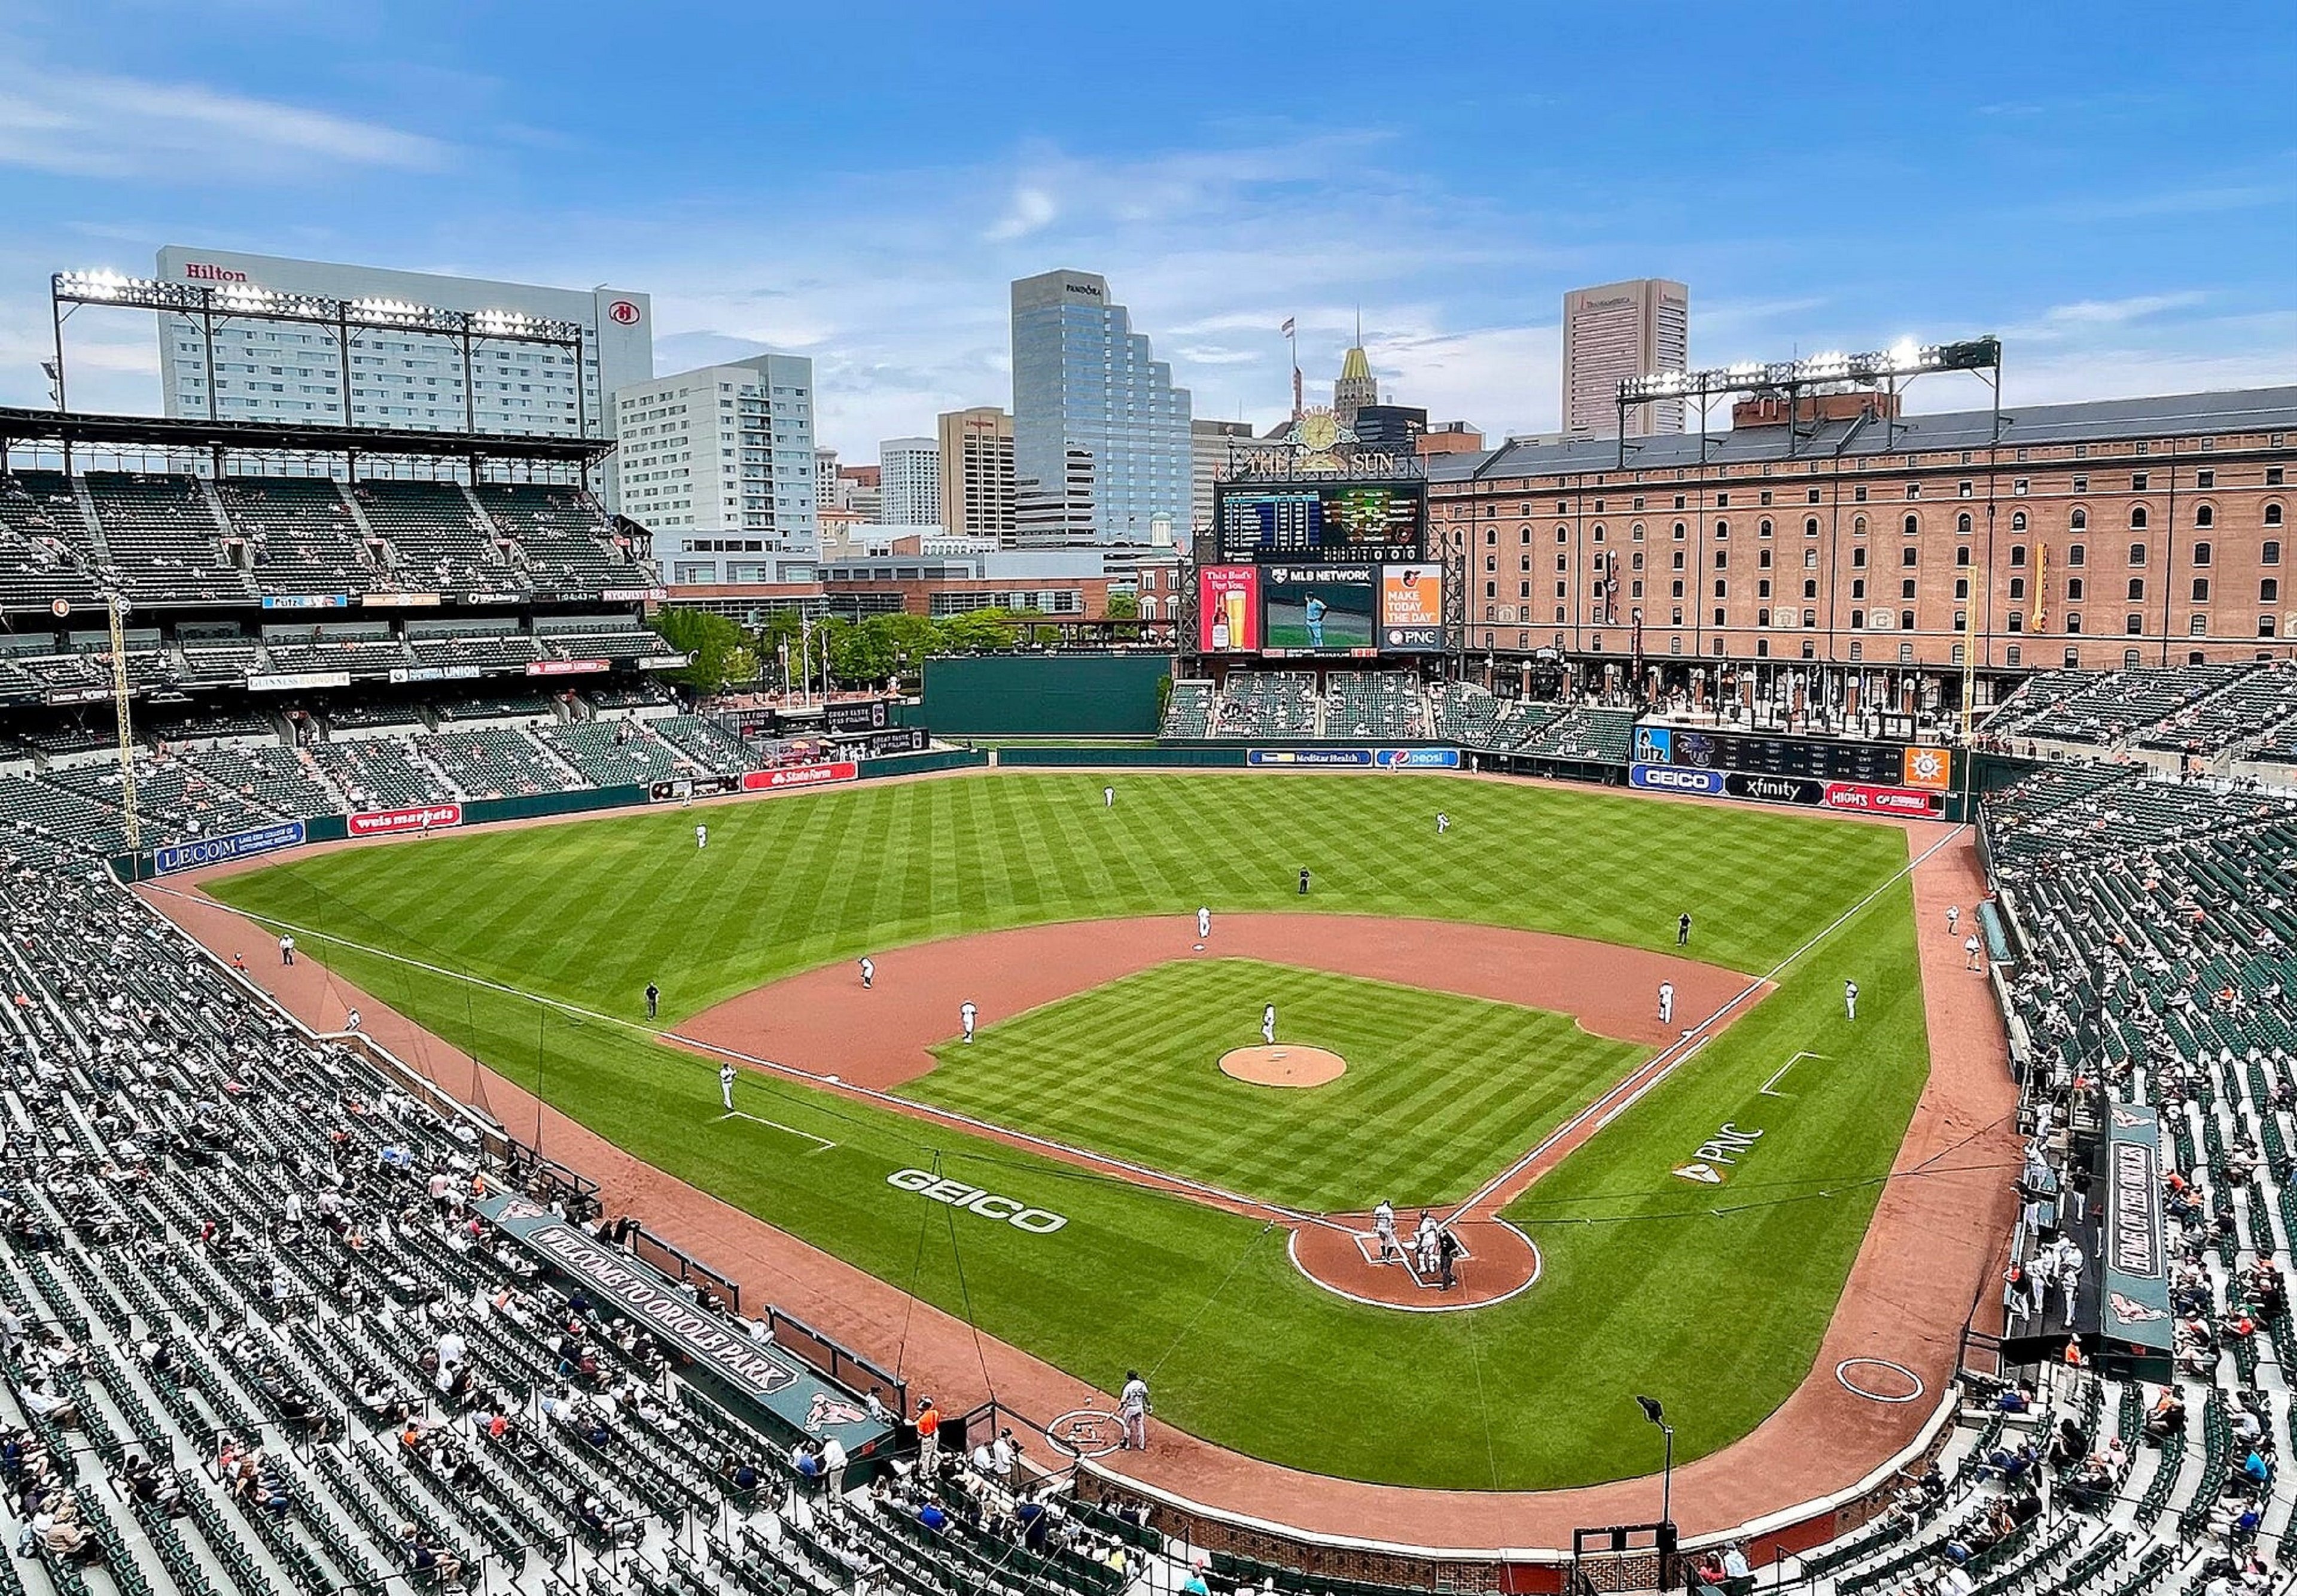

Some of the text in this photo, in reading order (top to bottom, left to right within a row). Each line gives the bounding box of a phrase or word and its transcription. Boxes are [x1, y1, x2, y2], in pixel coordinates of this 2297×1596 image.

[185, 263, 246, 282] Hilton
[1353, 453, 1395, 471] SUN
[1206, 571, 1227, 580] This
[1290, 571, 1314, 581] MLB
[1316, 570, 1370, 581] NETWORK
[1388, 591, 1420, 601] MAKE
[1387, 602, 1422, 611] TODAY
[1387, 613, 1410, 623] THE
[1405, 631, 1435, 644] PNC
[444, 666, 479, 677] UNION
[250, 677, 299, 688] GUINNESS
[1330, 753, 1358, 763] Health
[1412, 752, 1443, 763] pepsi
[785, 769, 832, 783] State Farm
[1646, 769, 1710, 789] GEICO
[1746, 778, 1801, 800] xfinity
[357, 815, 392, 829] weis
[164, 839, 237, 867] LECOM
[1692, 1122, 1765, 1165] PNC
[886, 1167, 1070, 1234] GEICO
[2118, 1145, 2151, 1272] HOME OF THE ORIOLES
[538, 1229, 788, 1389] WELCOME TO ORIOLE PARK
